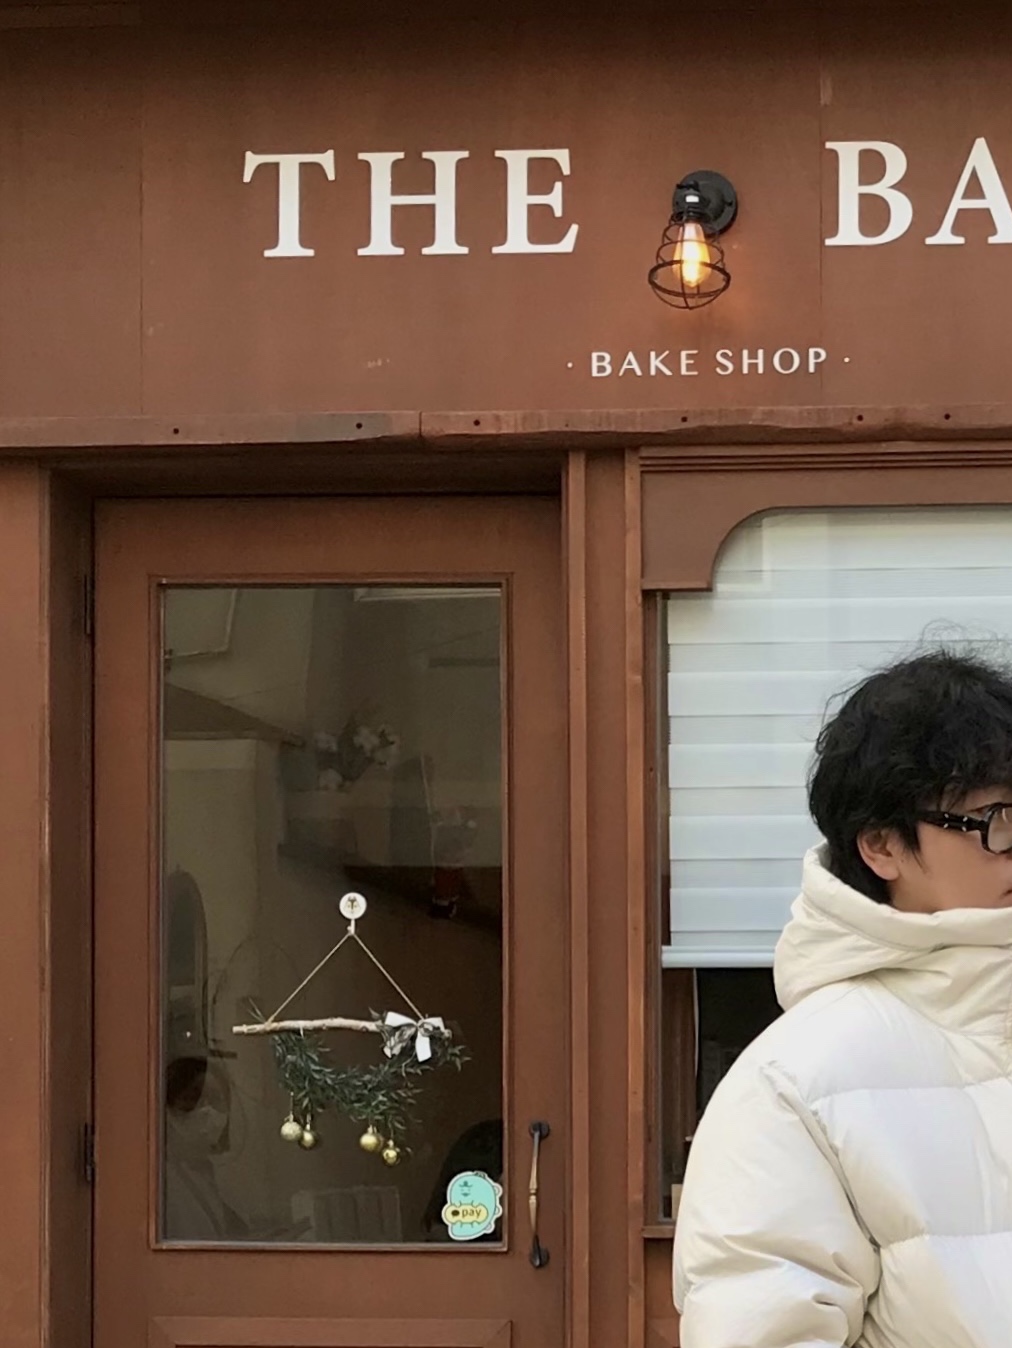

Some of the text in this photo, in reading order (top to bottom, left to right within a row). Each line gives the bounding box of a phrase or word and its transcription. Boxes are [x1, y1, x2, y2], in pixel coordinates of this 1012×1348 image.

[243, 148, 579, 258] THE
[590, 346, 828, 378] BAKE SHOP
[462, 1209, 482, 1218] pay
